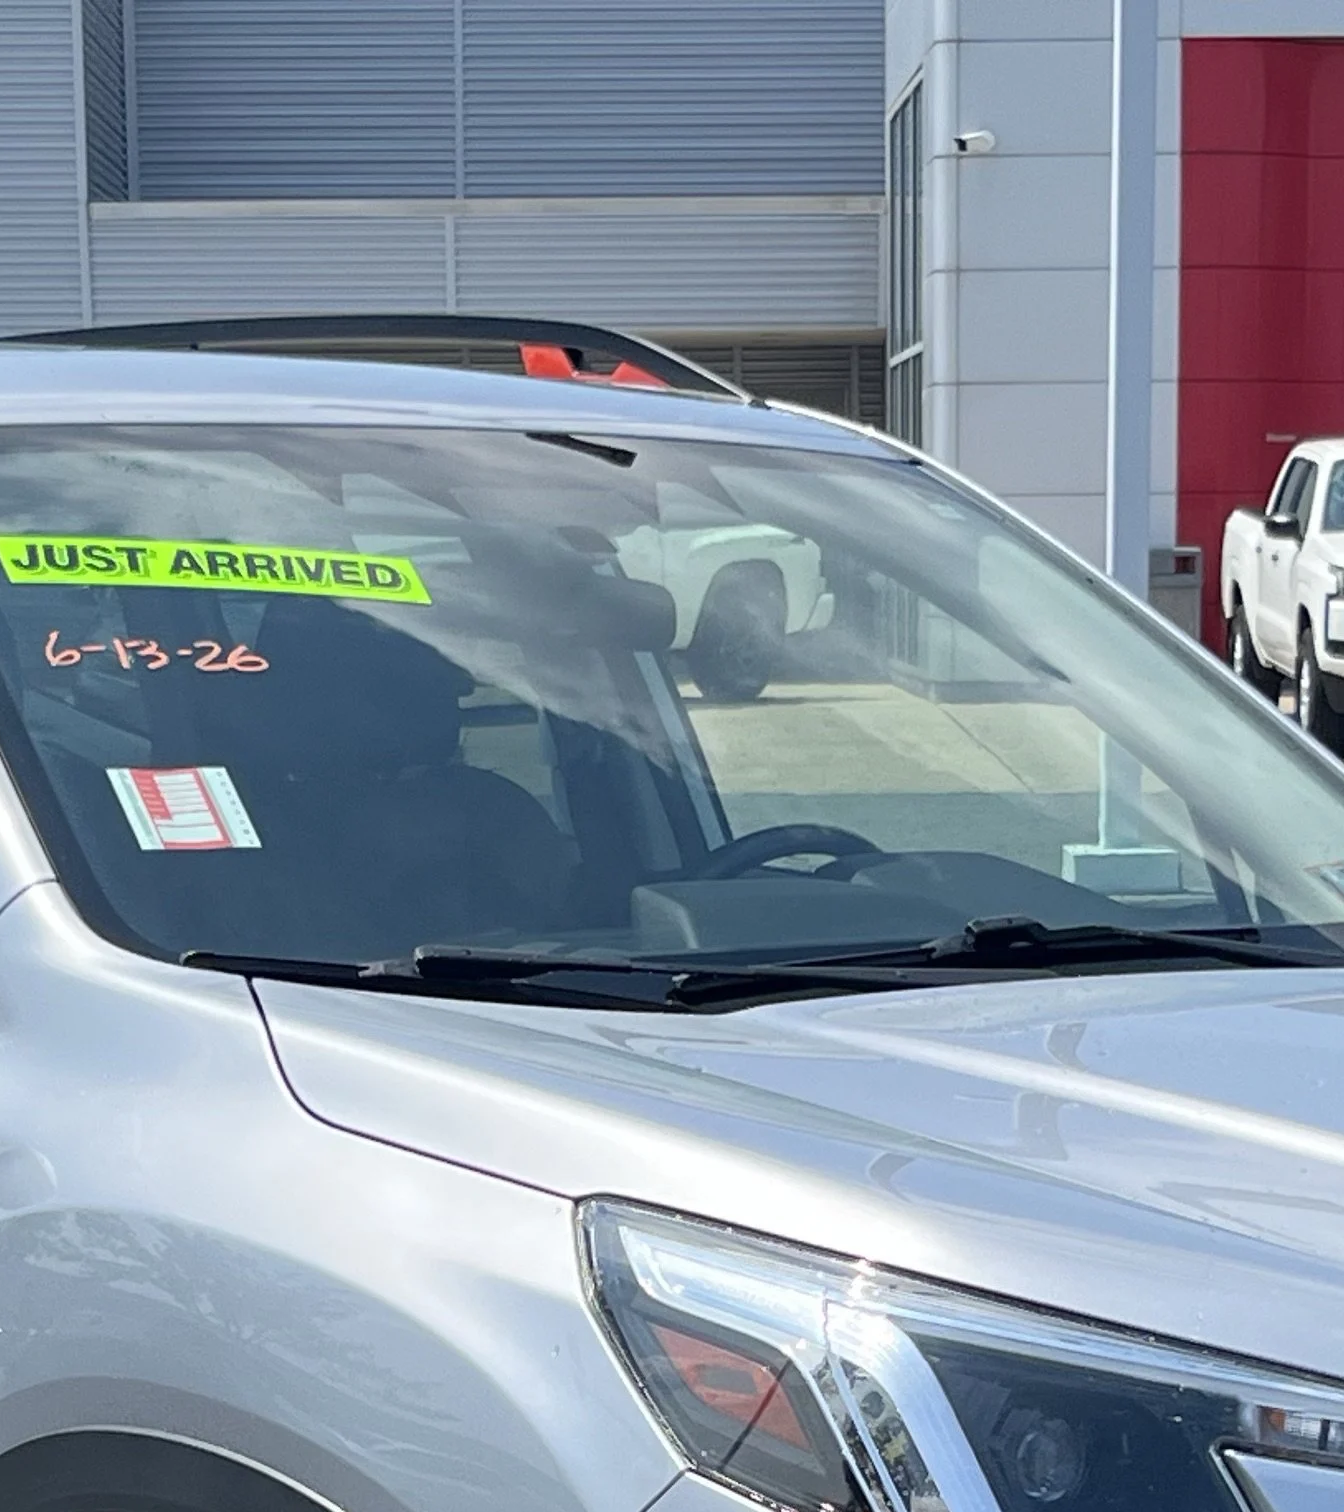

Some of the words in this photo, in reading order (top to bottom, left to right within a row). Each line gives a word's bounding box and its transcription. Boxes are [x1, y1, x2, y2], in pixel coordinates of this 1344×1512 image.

[11, 542, 153, 577] JUST
[168, 547, 410, 592] ARRIVED
[44, 629, 270, 673] 6-13-26
